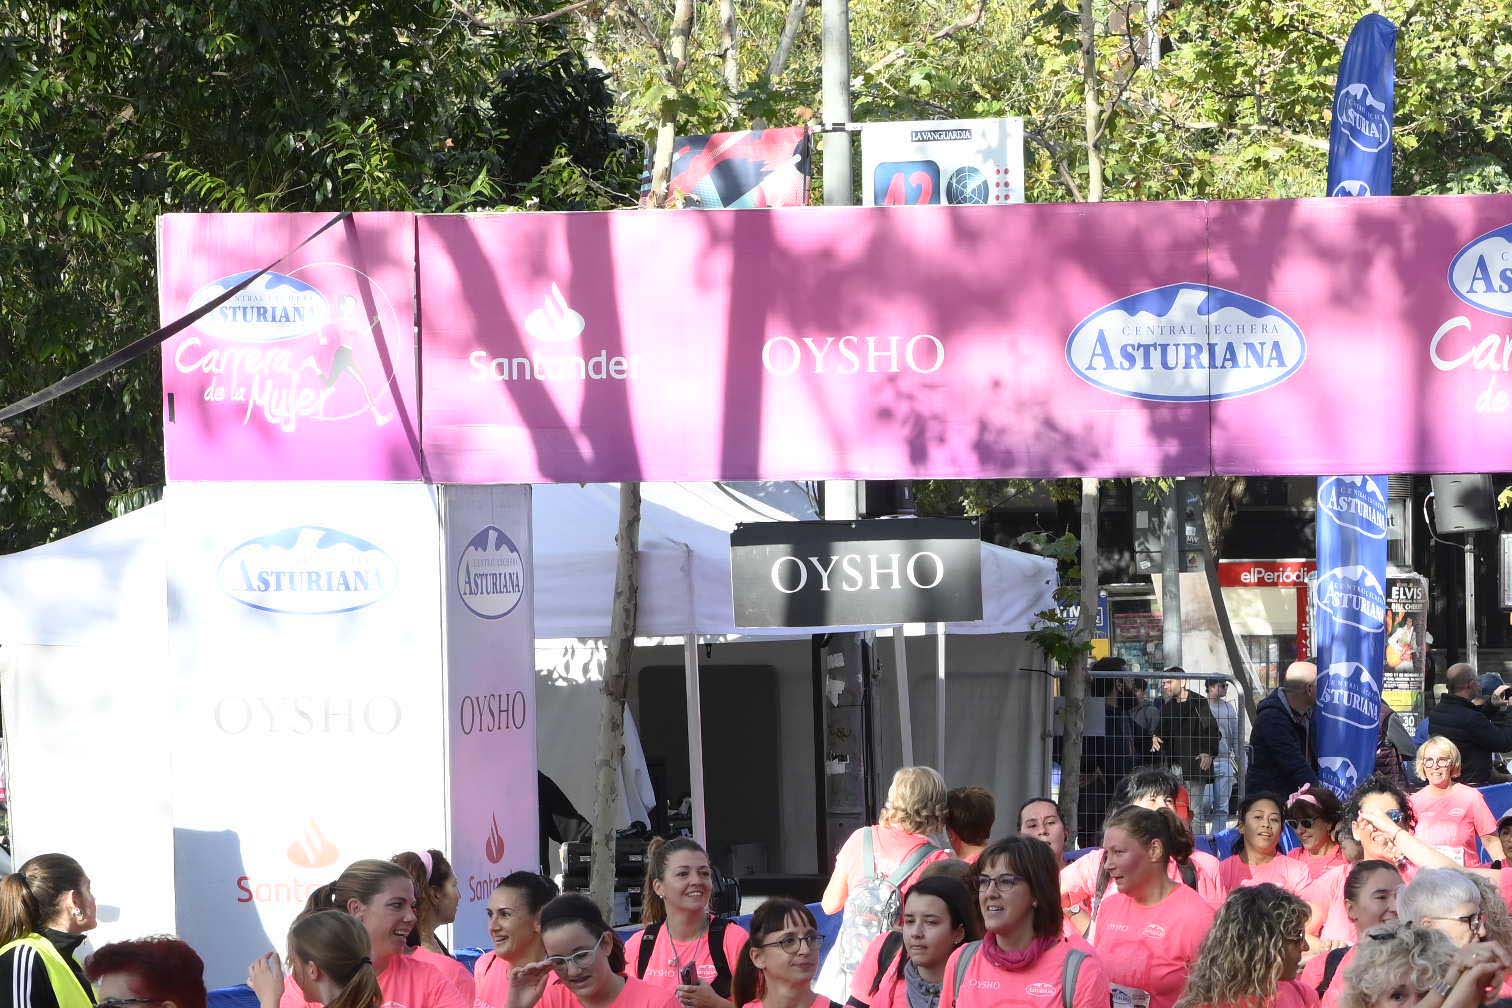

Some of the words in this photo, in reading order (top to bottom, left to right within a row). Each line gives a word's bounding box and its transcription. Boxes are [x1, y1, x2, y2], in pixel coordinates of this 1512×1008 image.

[1084, 328, 1287, 371] ASTURIANA
[1122, 325, 1196, 336] CENTRAL
[469, 349, 641, 381] Santander
[762, 334, 945, 376] OYSHO
[1476, 375, 1509, 415] de
[463, 562, 521, 597] ASTURIANA
[771, 551, 945, 595] OYSHO
[1391, 586, 1422, 600] ELVIS
[214, 696, 402, 735] OYSHO
[460, 690, 526, 736] OYSHO
